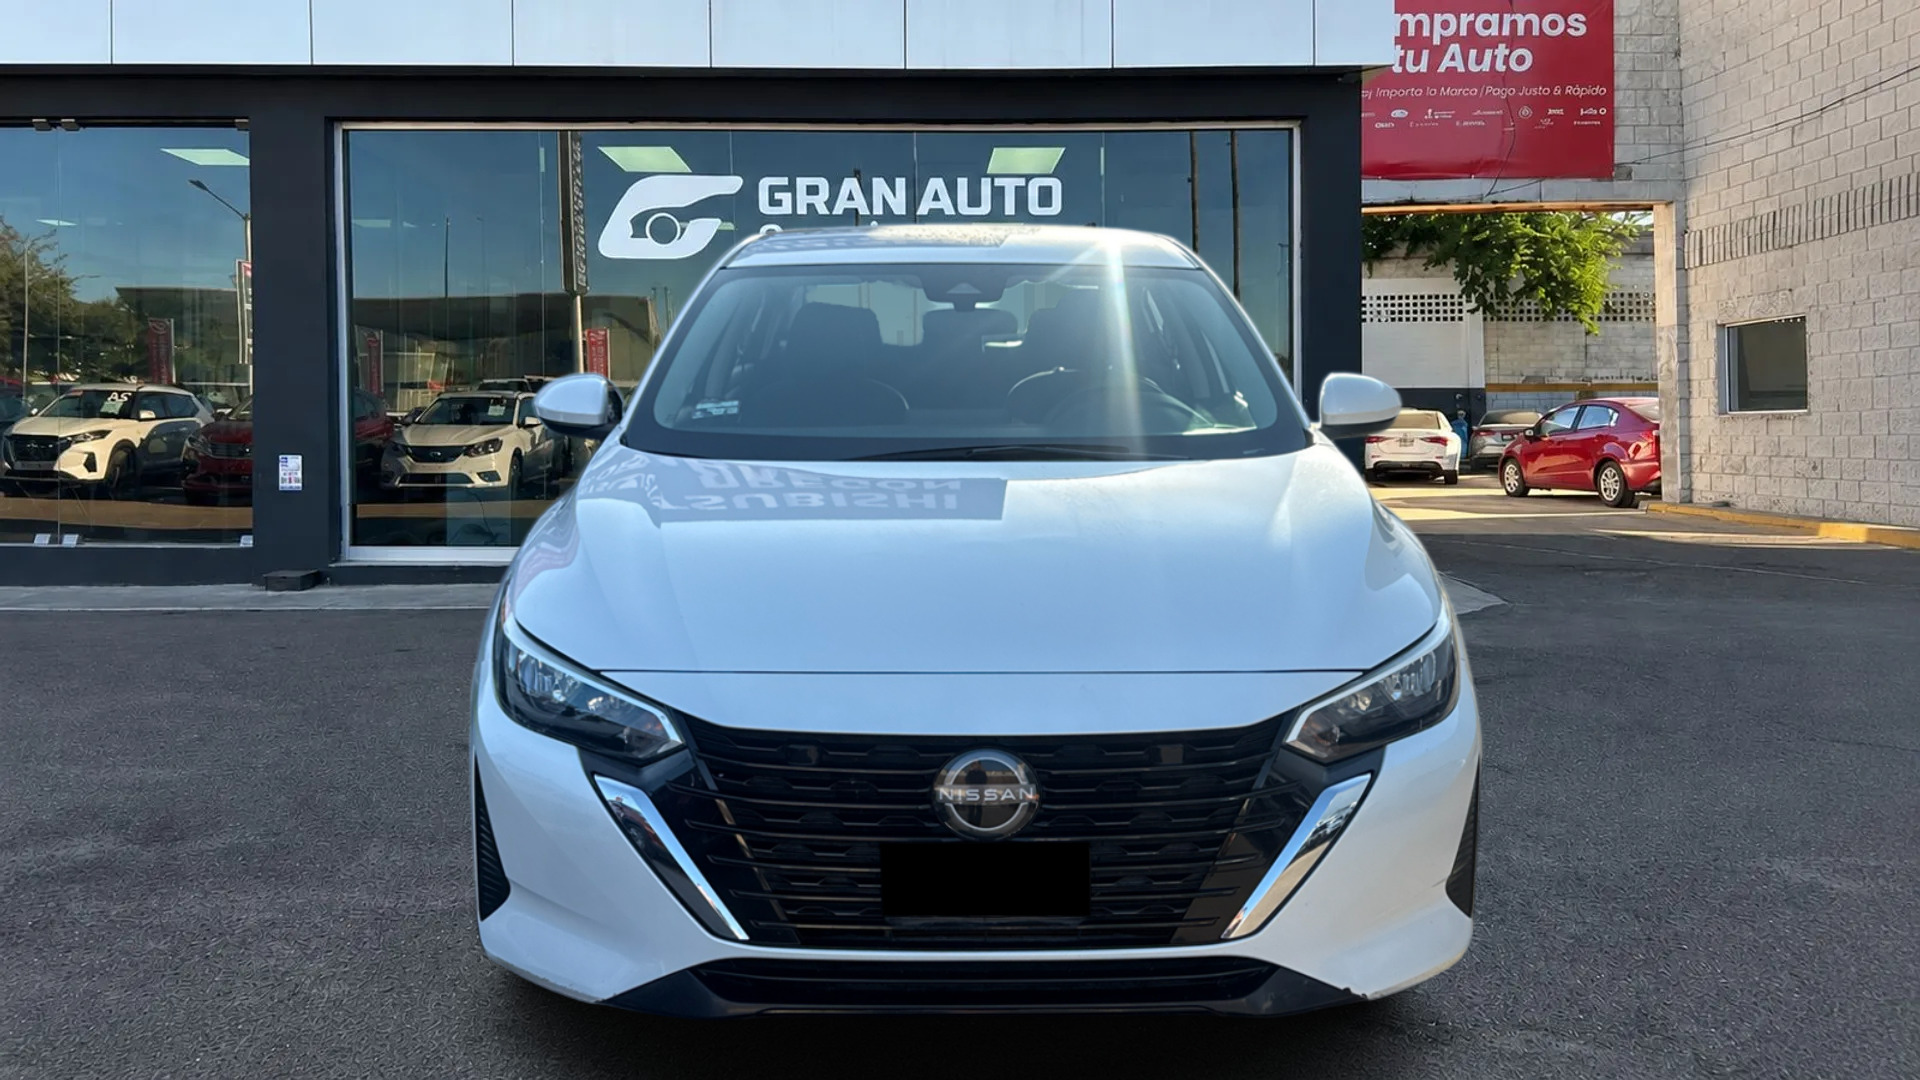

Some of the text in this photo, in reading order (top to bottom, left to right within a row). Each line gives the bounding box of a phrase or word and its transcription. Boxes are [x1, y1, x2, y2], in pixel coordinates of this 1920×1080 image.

[1392, 43, 1534, 73] tu Auto
[1376, 86, 1423, 99] Importa
[1426, 86, 1437, 97] la
[1440, 86, 1478, 97] Marca
[1519, 85, 1550, 96] Justo
[1553, 85, 1562, 96] &
[1565, 83, 1607, 98] Rápido
[758, 176, 1063, 215] GRAN AUTO
[939, 787, 1033, 803] NISSAN
